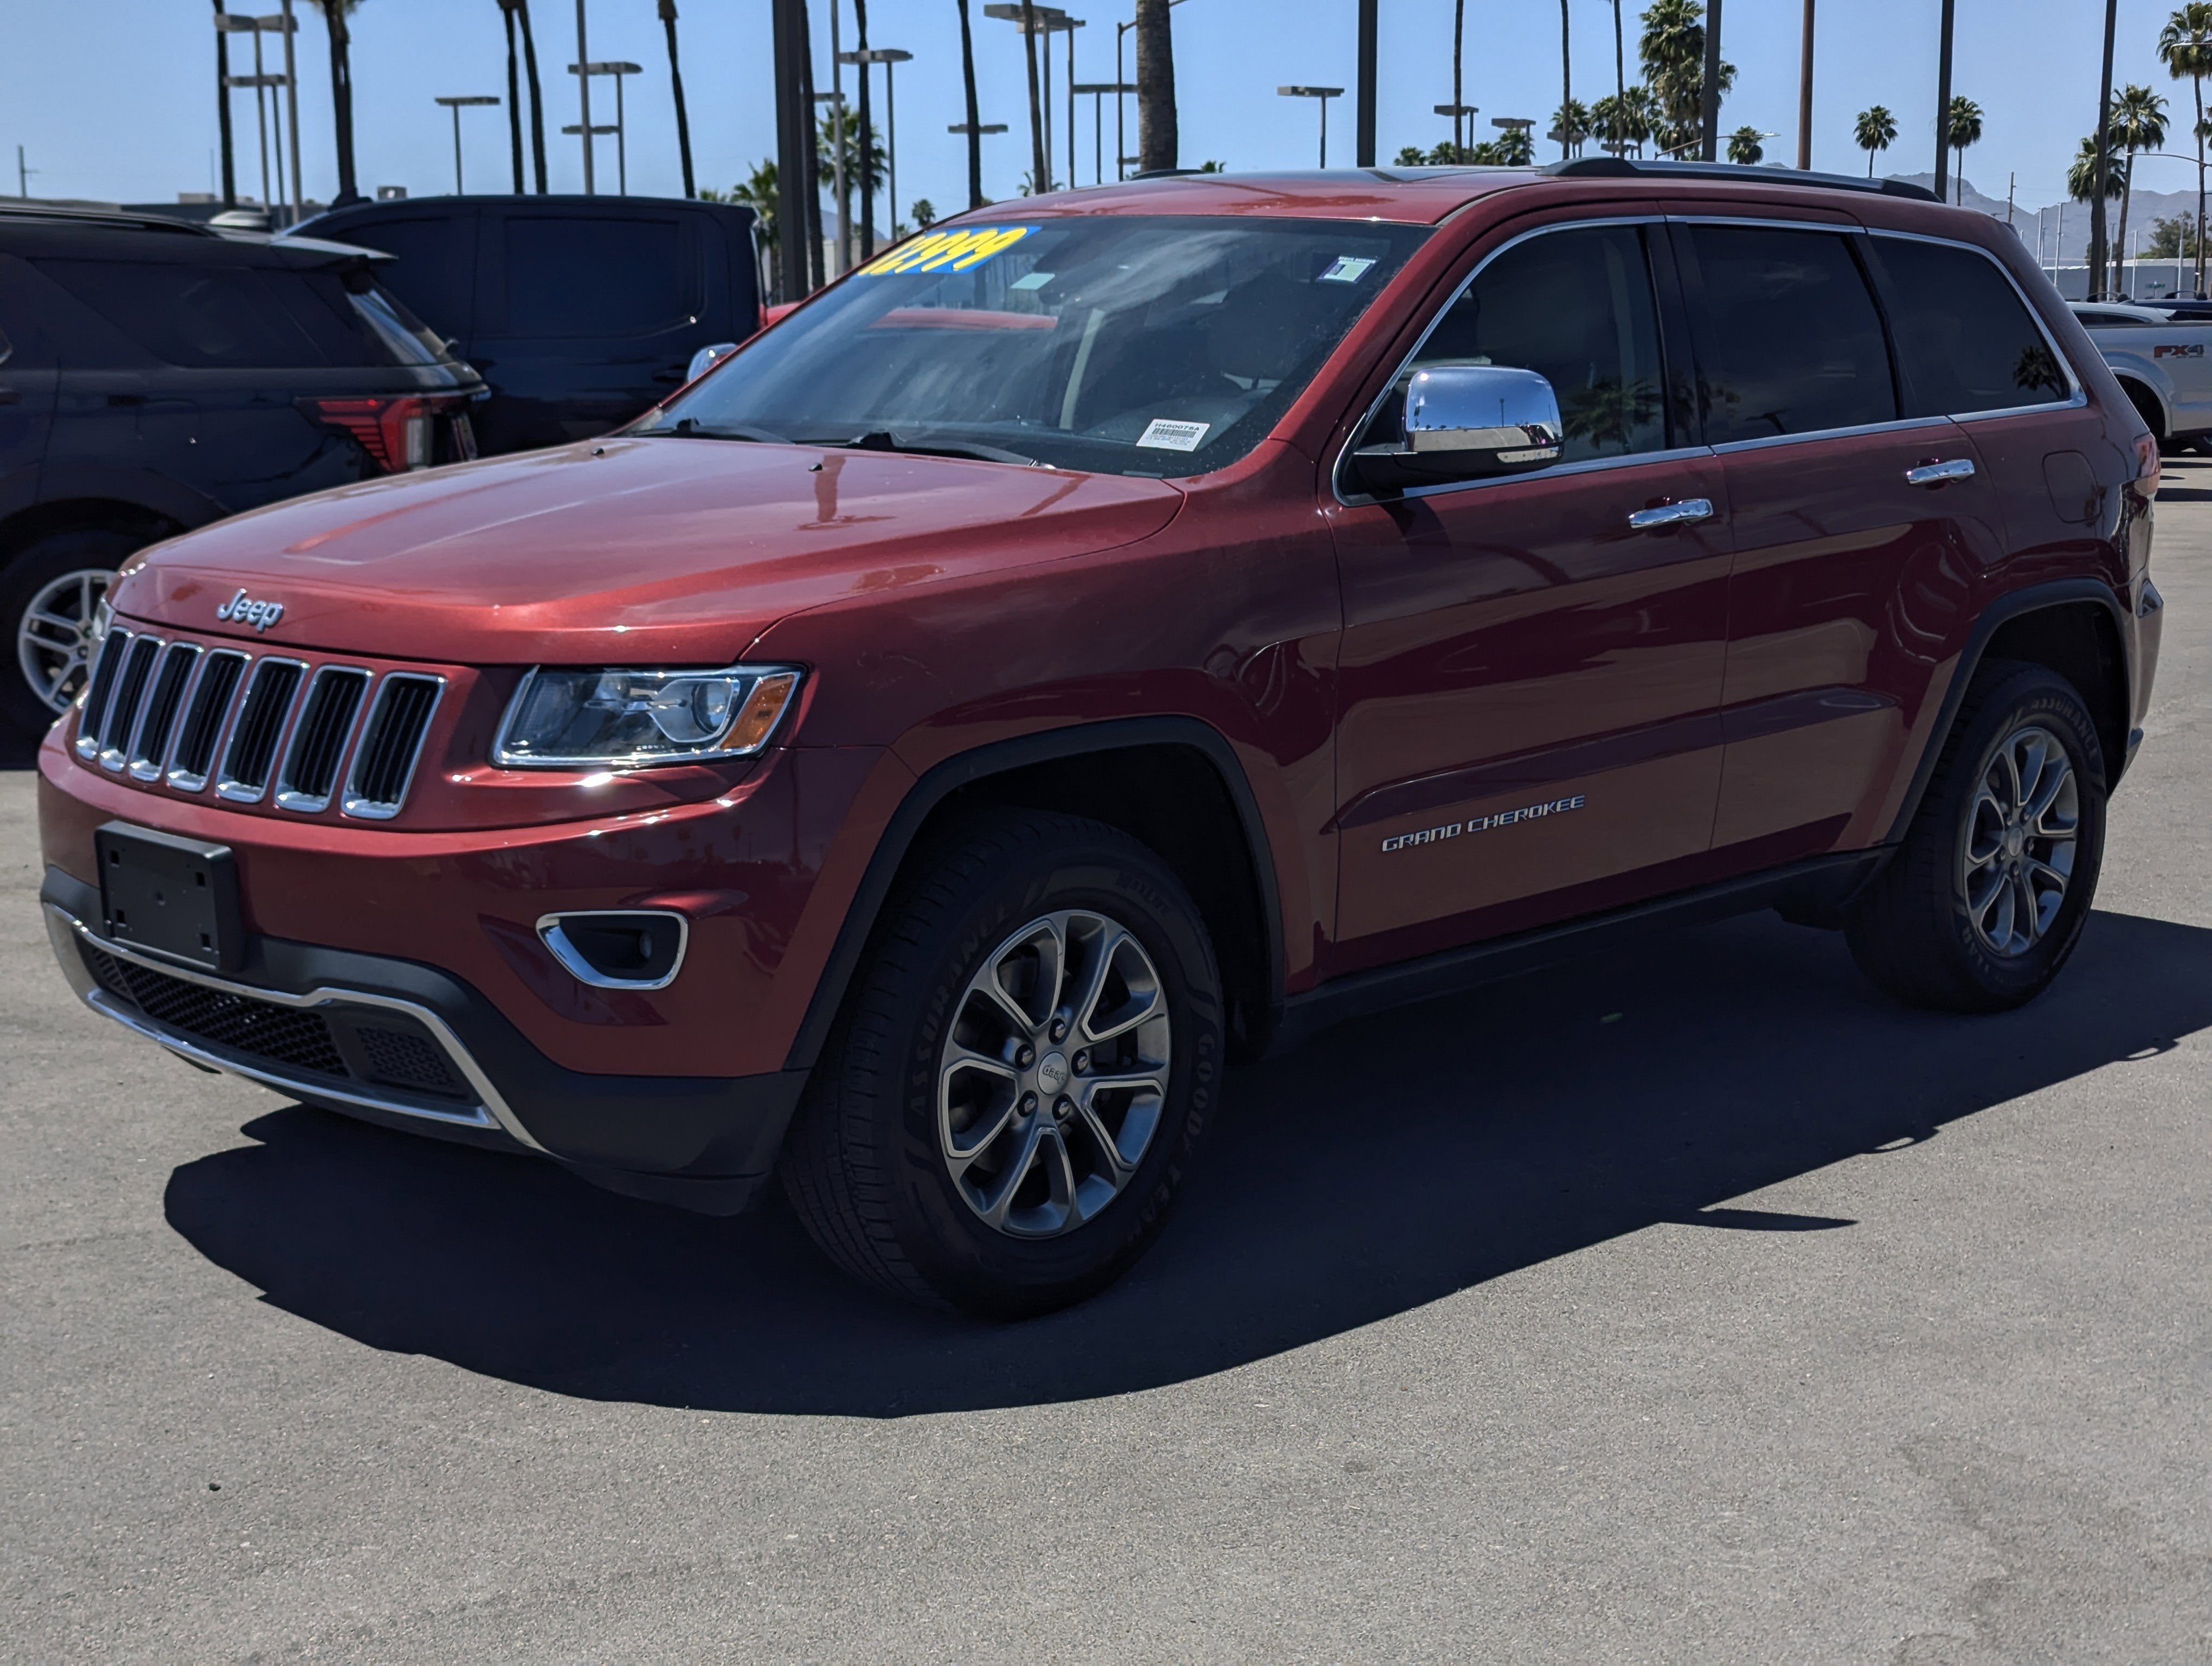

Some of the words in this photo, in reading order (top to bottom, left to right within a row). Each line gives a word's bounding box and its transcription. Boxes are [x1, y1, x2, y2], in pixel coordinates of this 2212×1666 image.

[2154, 344, 2204, 357] FX4
[216, 588, 284, 633] Jeep
[1381, 822, 1462, 852] GRAND
[1467, 795, 1585, 832] CHEROKEE
